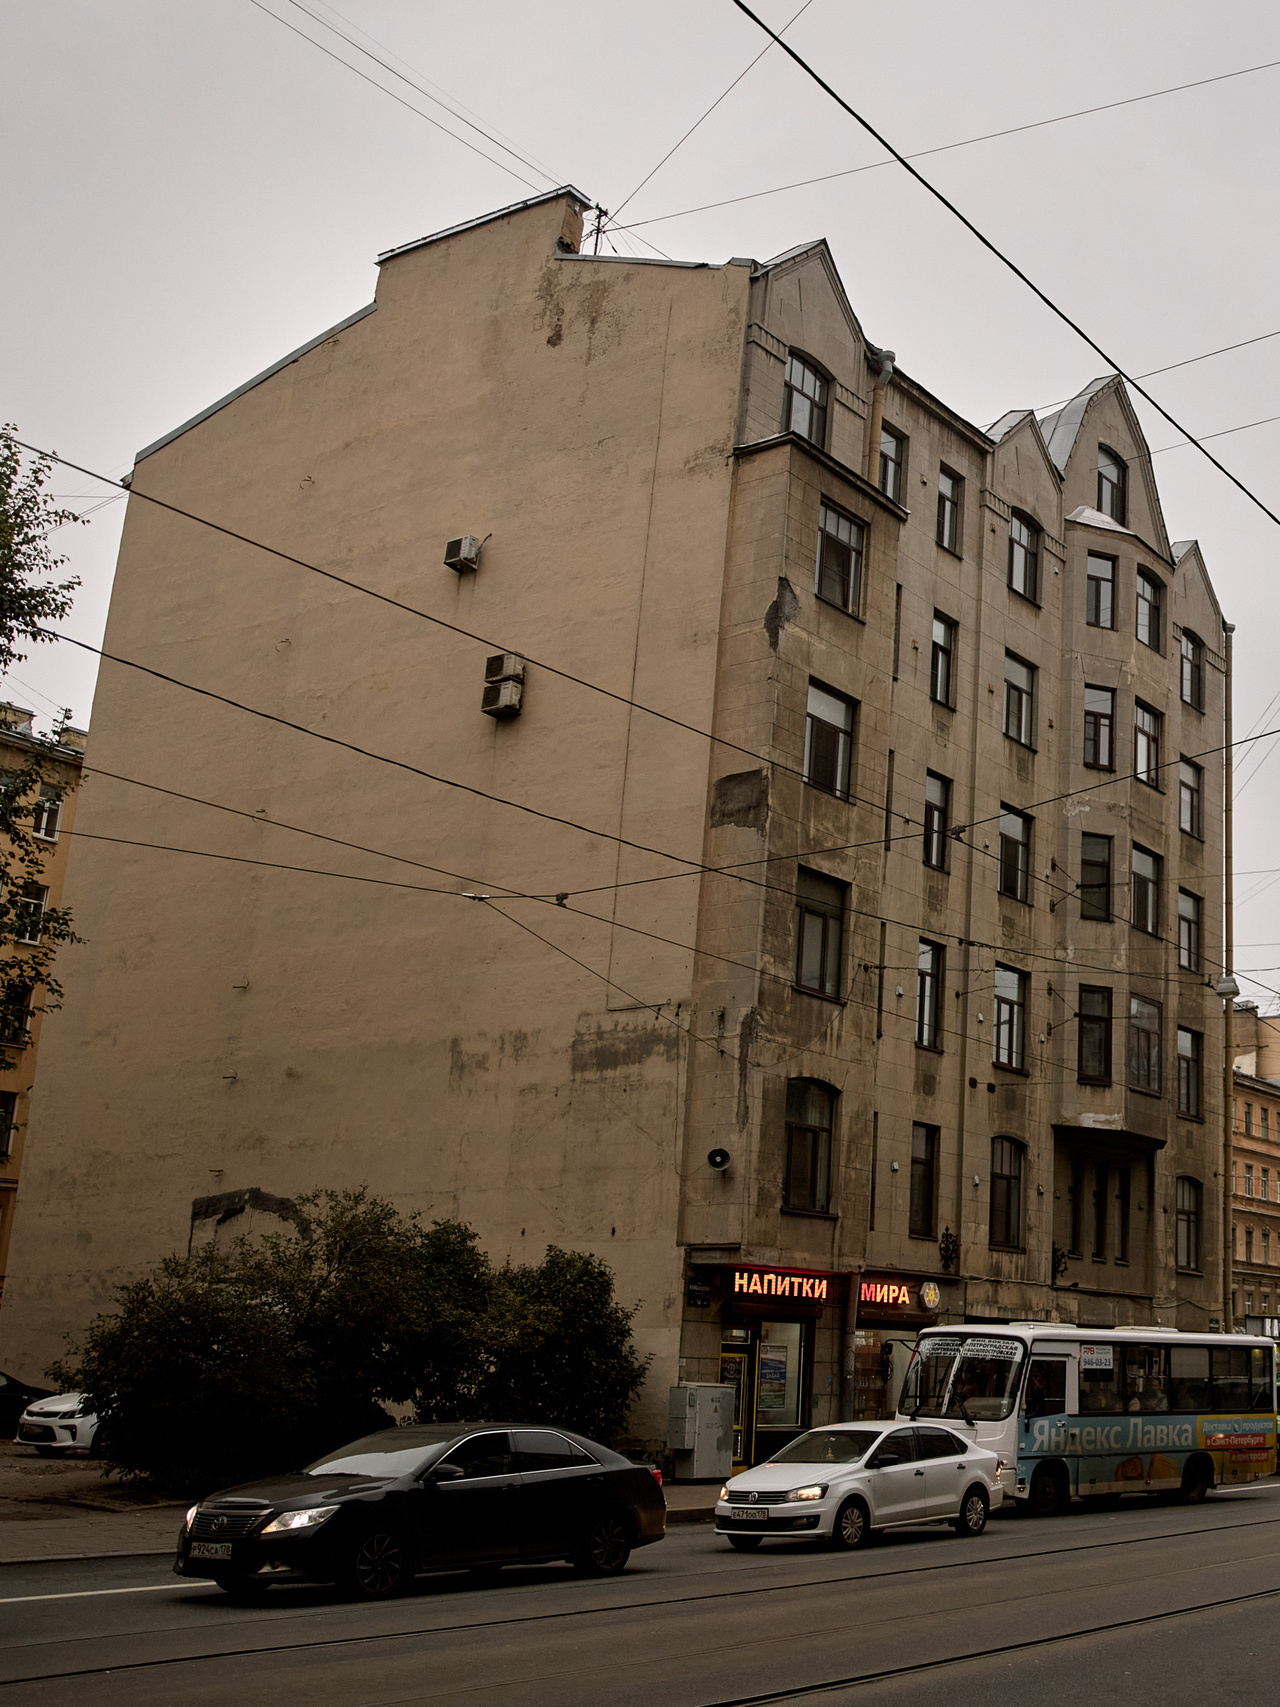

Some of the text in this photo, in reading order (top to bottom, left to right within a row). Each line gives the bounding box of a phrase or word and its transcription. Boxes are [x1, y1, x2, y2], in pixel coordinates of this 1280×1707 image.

[734, 1272, 910, 1304] НАПИТКИ МИРА
[1032, 1418, 1193, 1455] Яндекс Лавка
[1203, 1422, 1232, 1433] Доставка
[1242, 1421, 1274, 1432] продуктов
[1211, 1435, 1264, 1447] Санкт-Петербурге
